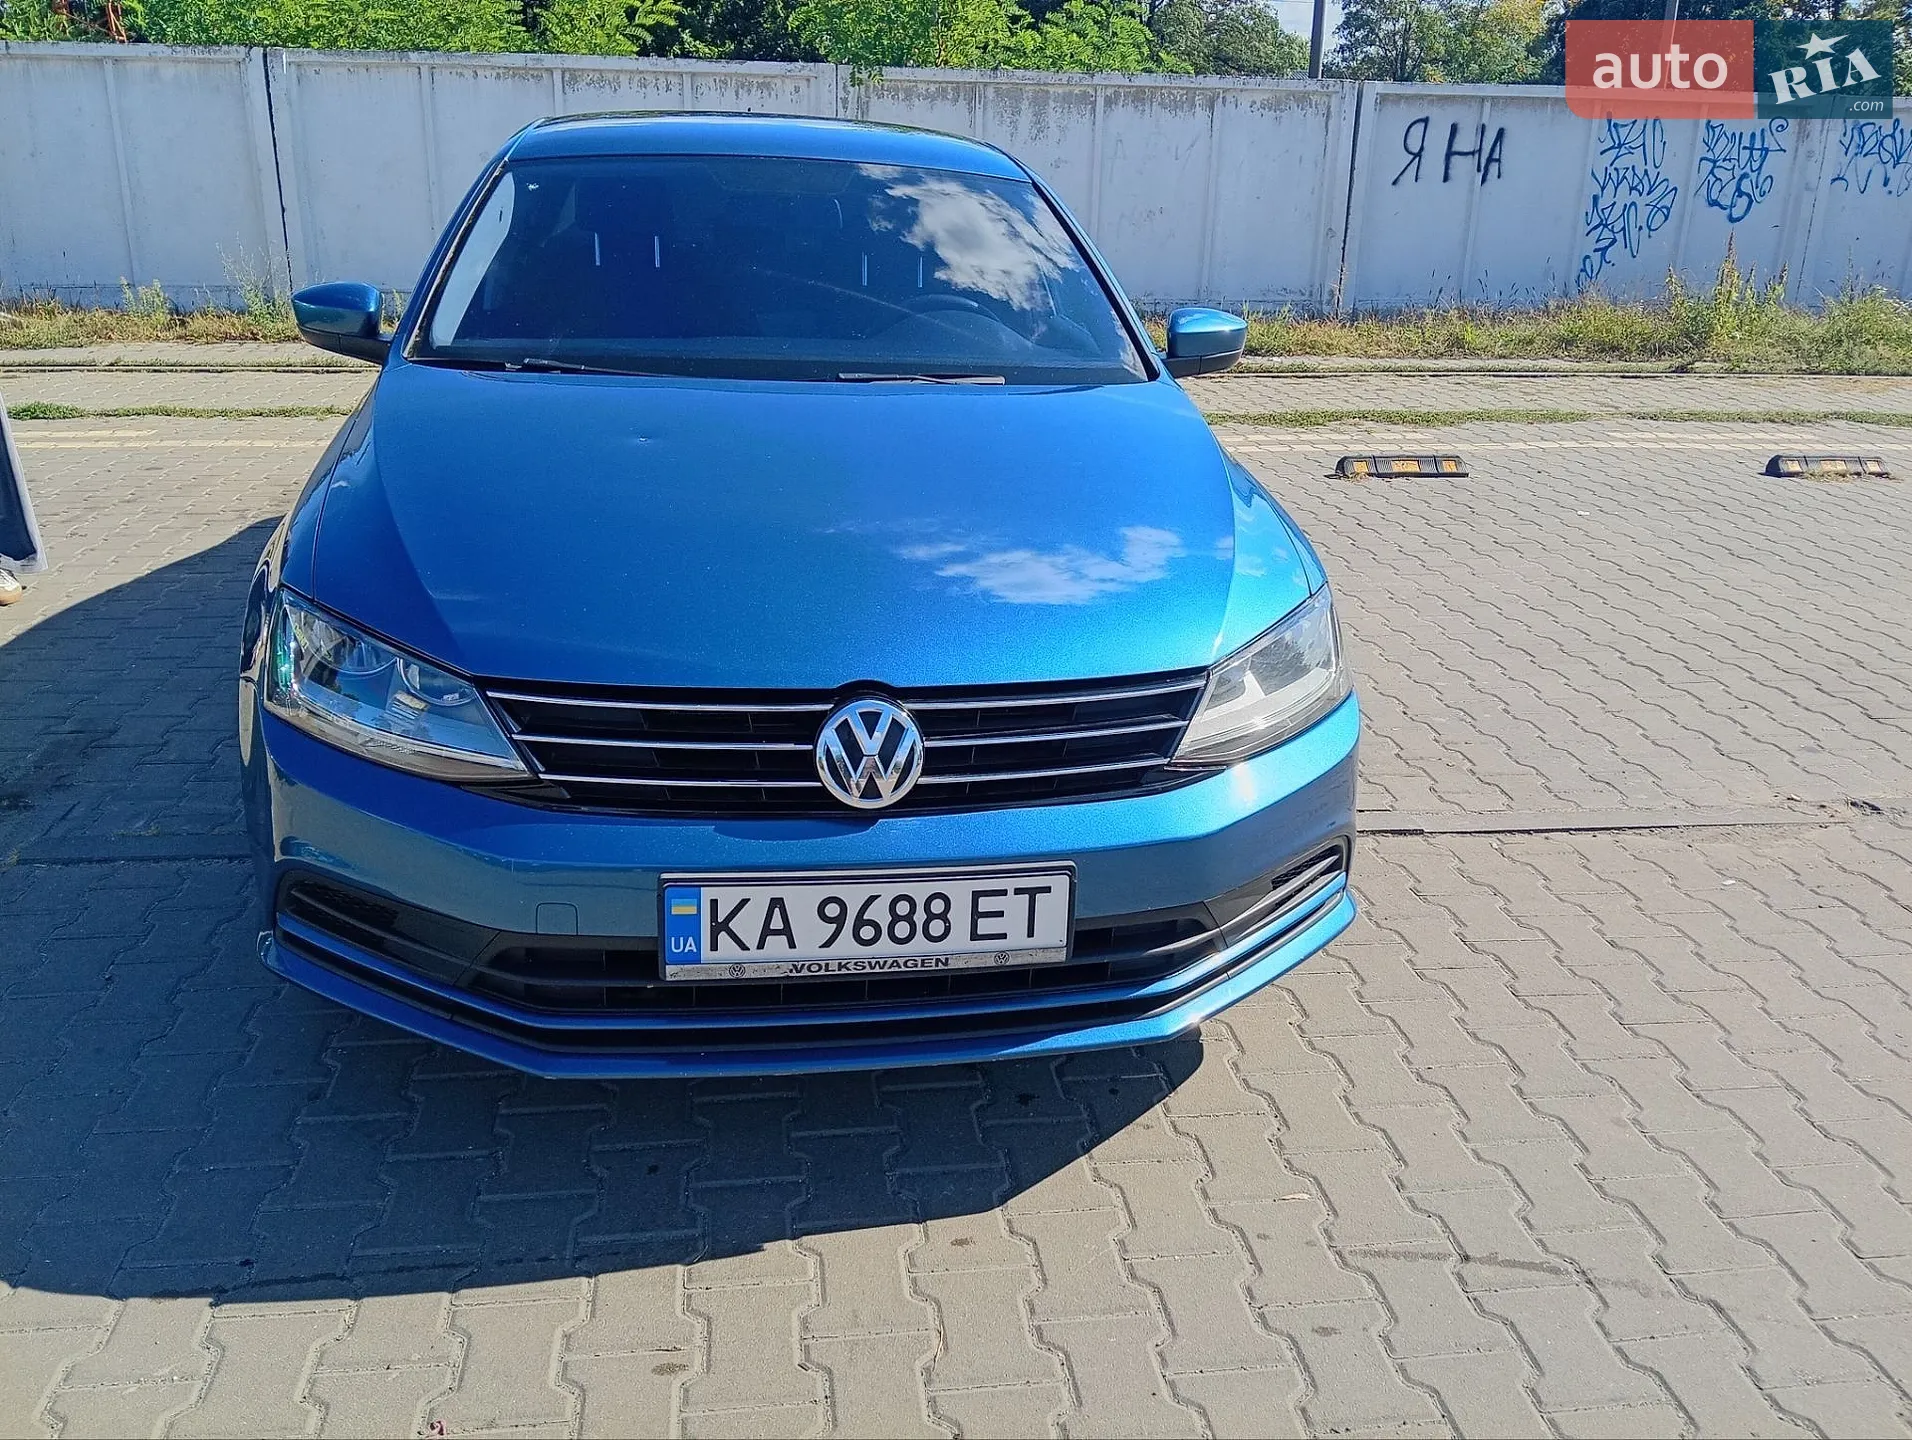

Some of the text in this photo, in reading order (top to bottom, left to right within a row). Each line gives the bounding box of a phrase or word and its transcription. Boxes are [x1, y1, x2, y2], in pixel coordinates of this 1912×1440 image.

[709, 885, 1052, 952] KA 9688 ET
[671, 936, 698, 953] UA
[791, 957, 950, 974] VOLKSWAGEN
